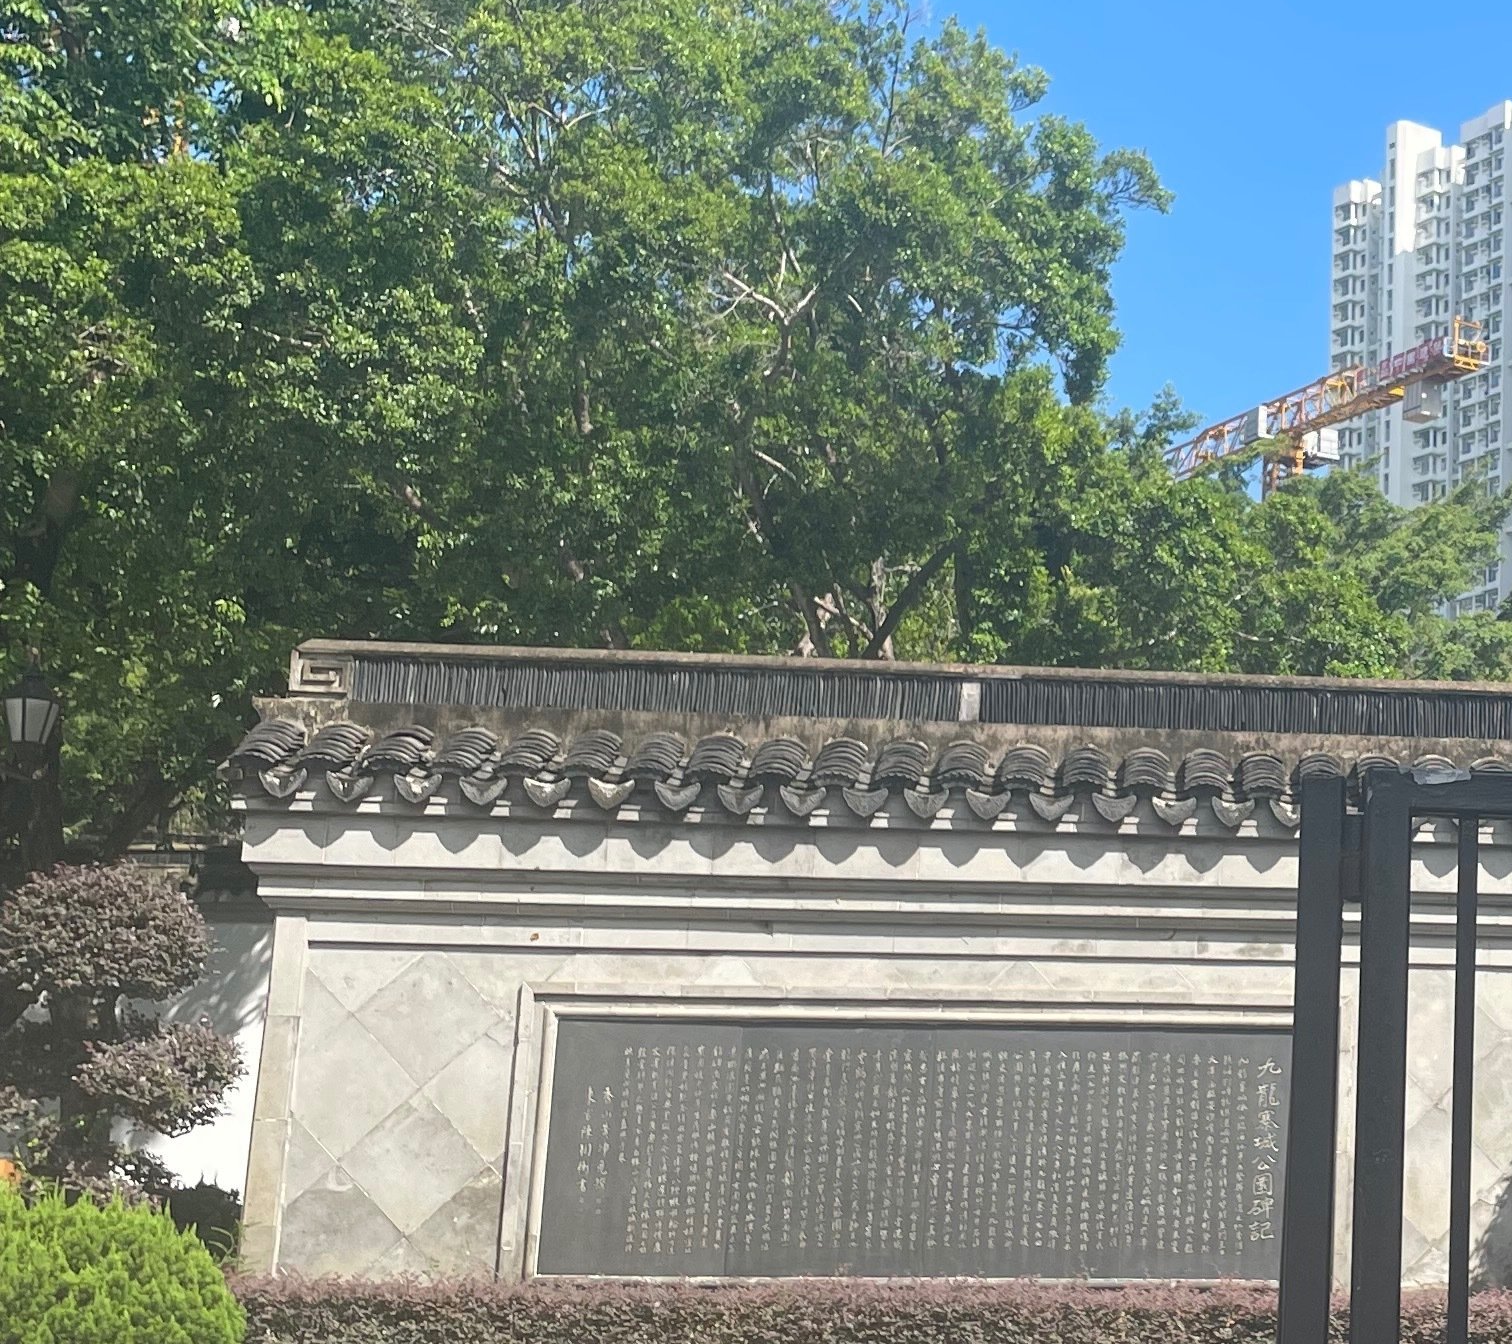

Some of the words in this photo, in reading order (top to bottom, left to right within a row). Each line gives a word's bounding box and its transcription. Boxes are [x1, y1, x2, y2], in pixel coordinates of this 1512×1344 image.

[1247, 1057, 1283, 1241] 九龍寨城公園碑記
